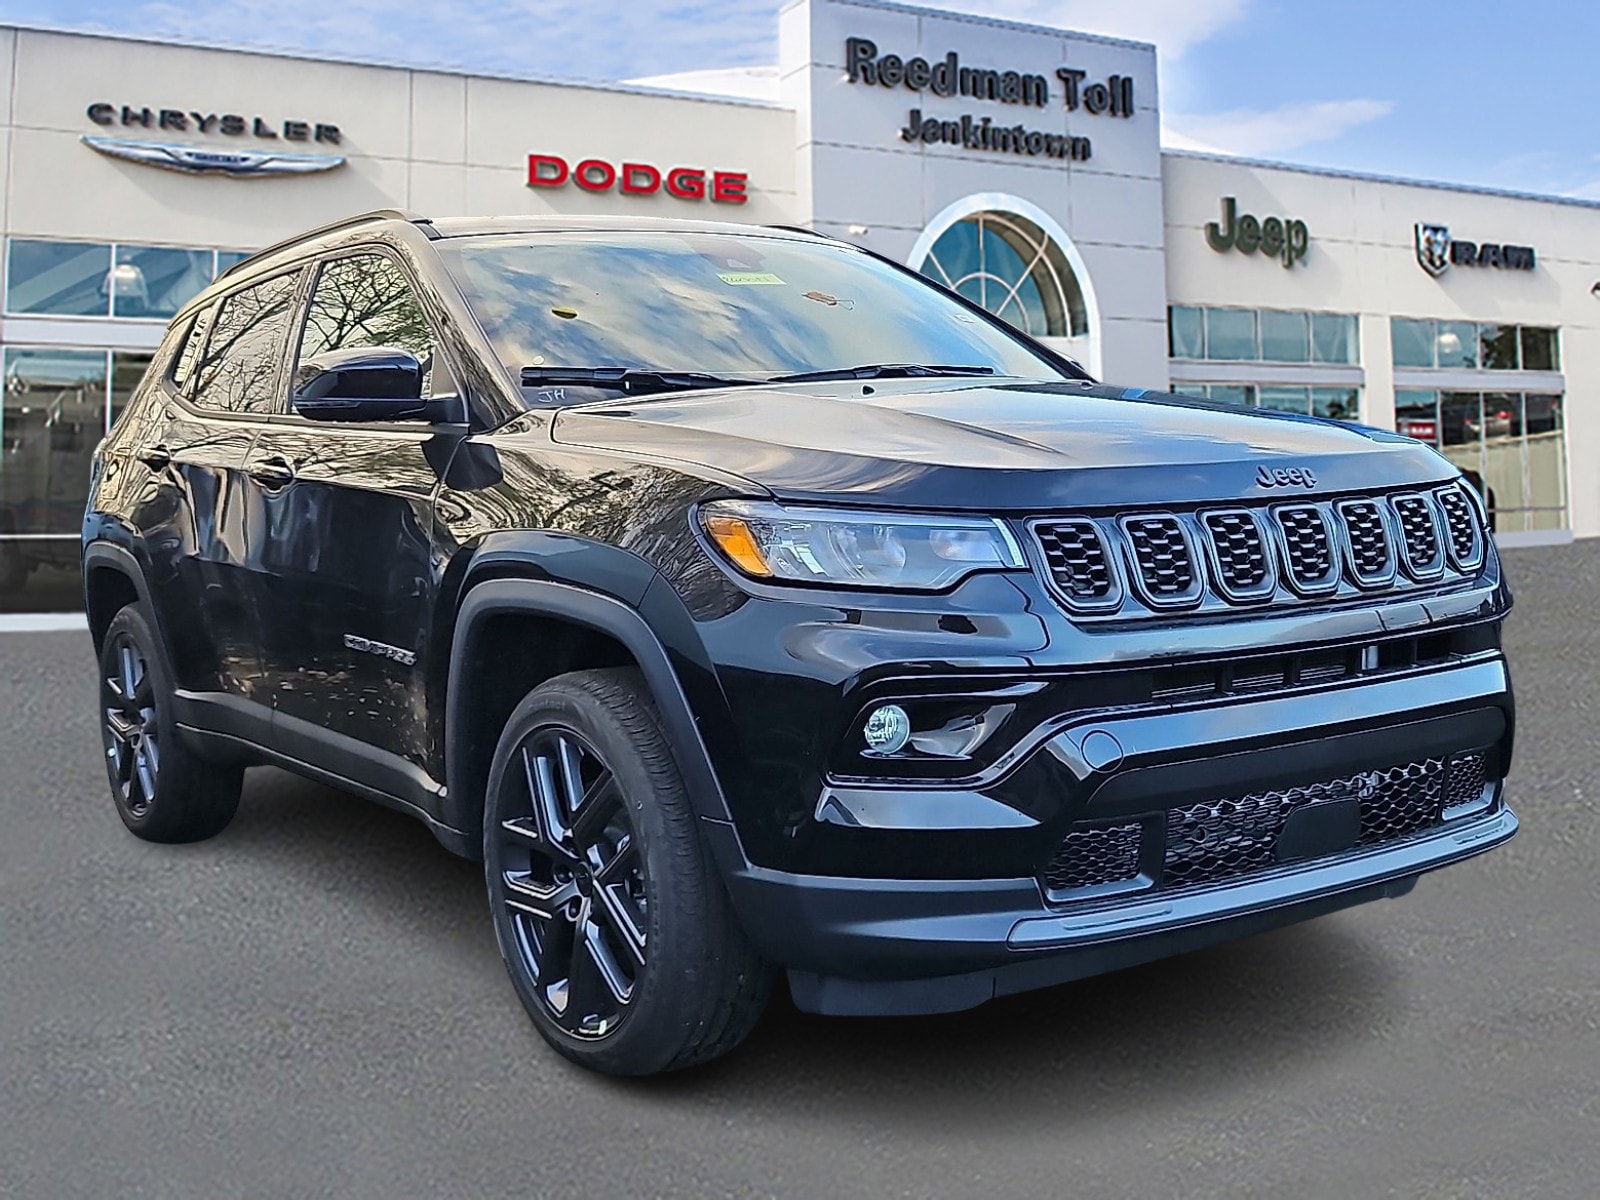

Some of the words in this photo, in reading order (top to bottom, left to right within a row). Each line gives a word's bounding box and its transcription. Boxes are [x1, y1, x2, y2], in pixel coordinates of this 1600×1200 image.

[846, 37, 1048, 107] Reedman
[1056, 68, 1134, 117] Toll
[87, 102, 341, 144] CHRYSLER
[901, 109, 1091, 161] Jenkintown
[527, 153, 749, 203] DODGE
[1205, 197, 1308, 268] Jeep
[1450, 241, 1535, 270] RAM
[1255, 465, 1317, 488] Jeep
